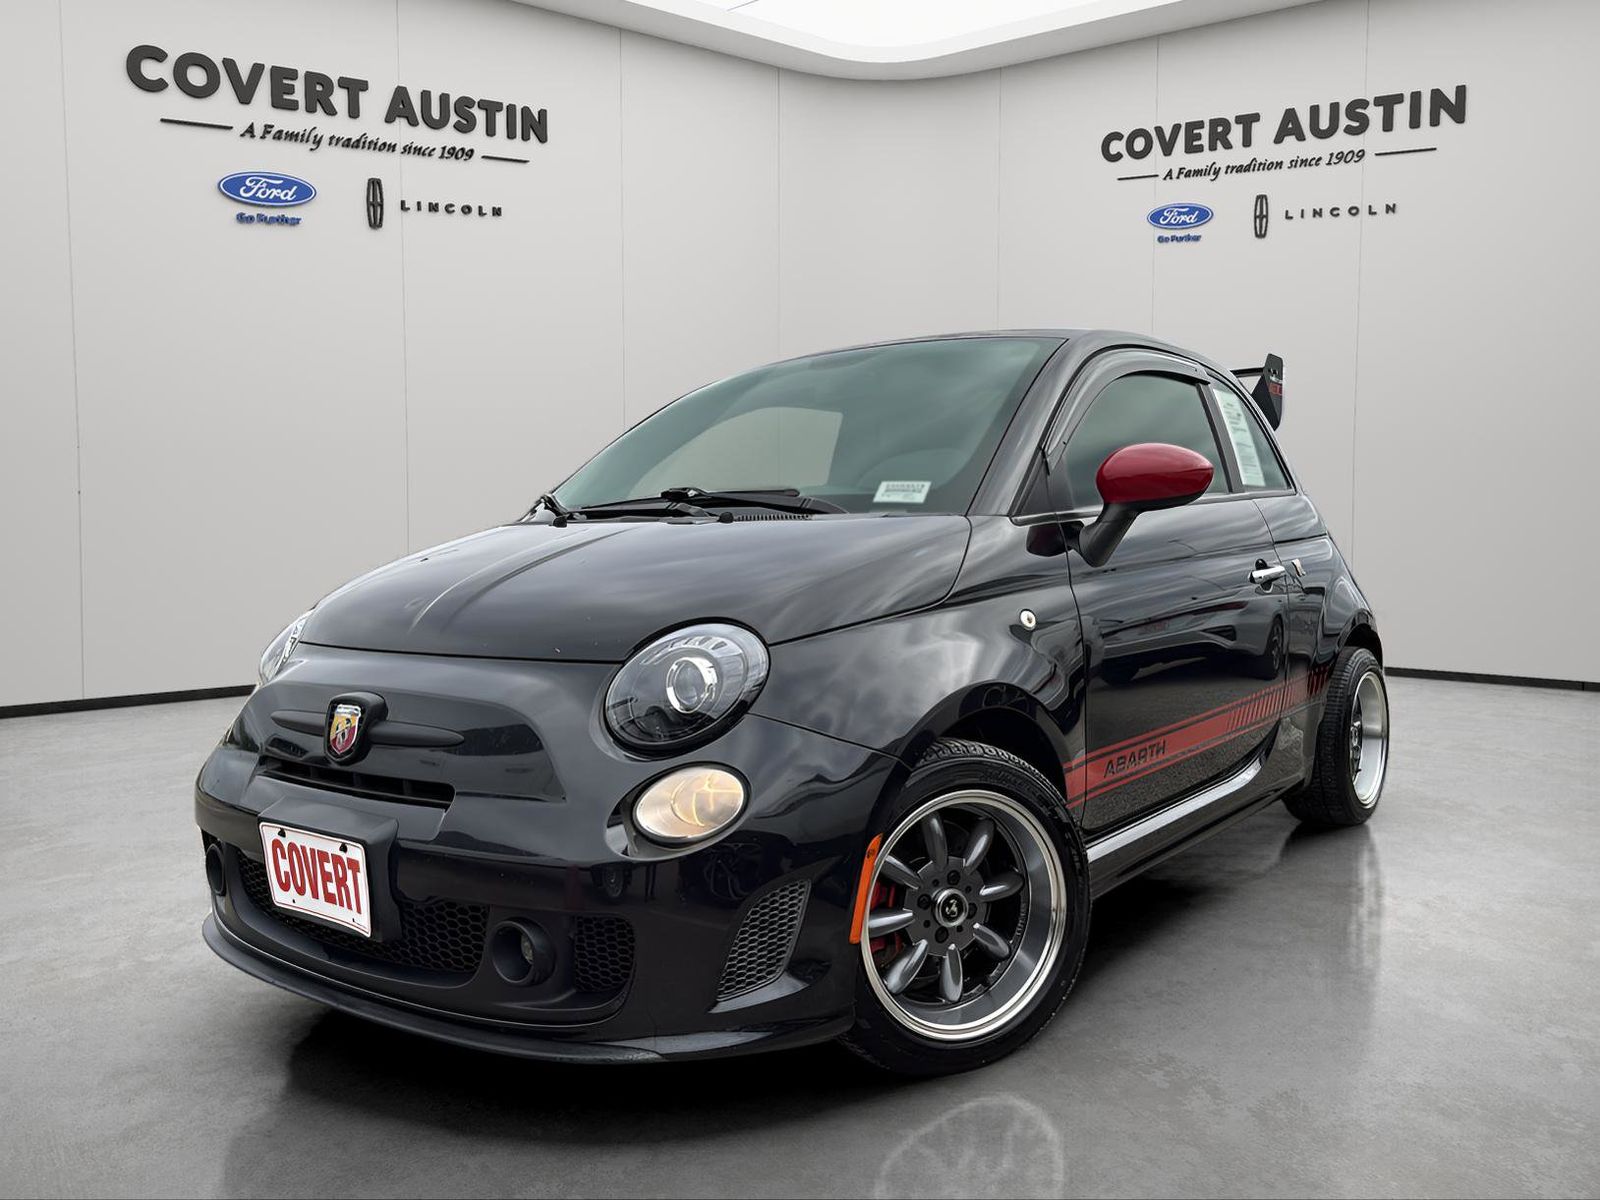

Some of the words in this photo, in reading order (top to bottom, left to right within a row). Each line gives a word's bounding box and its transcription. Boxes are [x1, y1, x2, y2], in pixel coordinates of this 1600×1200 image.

[126, 44, 369, 119] COVERT
[384, 85, 548, 143] AUSTIN
[1100, 112, 1261, 163] COVERT
[1273, 84, 1467, 145] AUSTIN
[239, 122, 256, 139] A
[259, 123, 324, 152] Family
[328, 132, 397, 154] tradition
[400, 140, 437, 159] since
[438, 145, 475, 162] 1909
[1163, 168, 1174, 181] A
[1176, 161, 1222, 182] Family
[1224, 157, 1284, 175] tradition
[1287, 156, 1323, 170] since
[1325, 149, 1366, 166] 1909
[239, 176, 297, 200] Ford
[400, 199, 503, 217] LINCOLN
[1160, 208, 1199, 224] Ford
[1284, 202, 1397, 220] LINCOLN
[1103, 738, 1166, 778] ABARTH
[272, 839, 362, 914] COVERT
